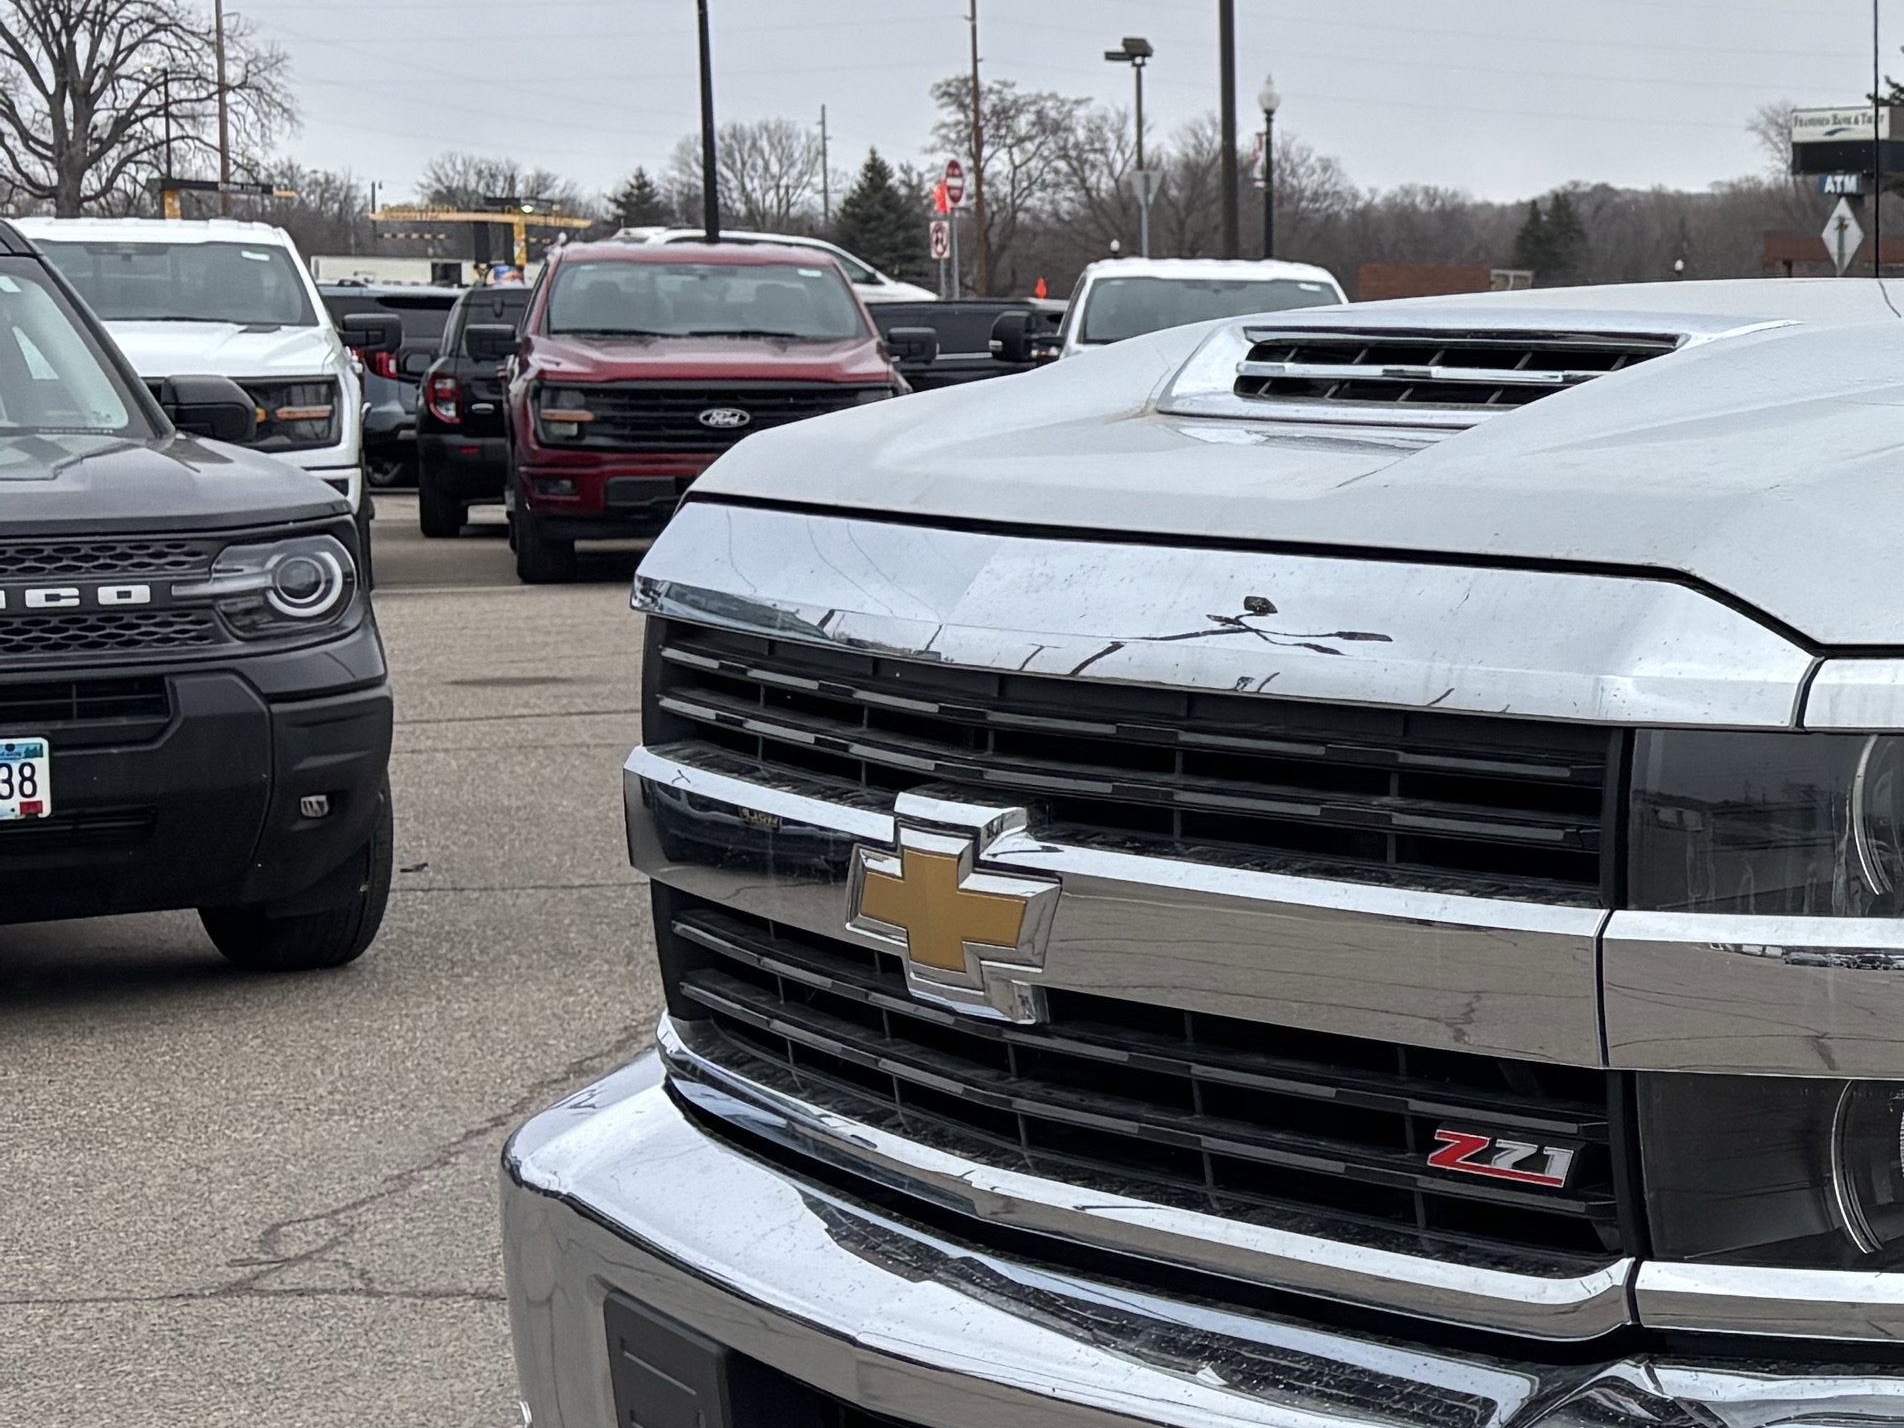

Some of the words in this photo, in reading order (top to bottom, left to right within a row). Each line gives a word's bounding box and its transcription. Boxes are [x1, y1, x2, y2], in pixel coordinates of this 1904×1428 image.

[1823, 175, 1858, 193] ATM
[0, 585, 151, 608] CO
[1427, 1129, 1575, 1189] Z71
